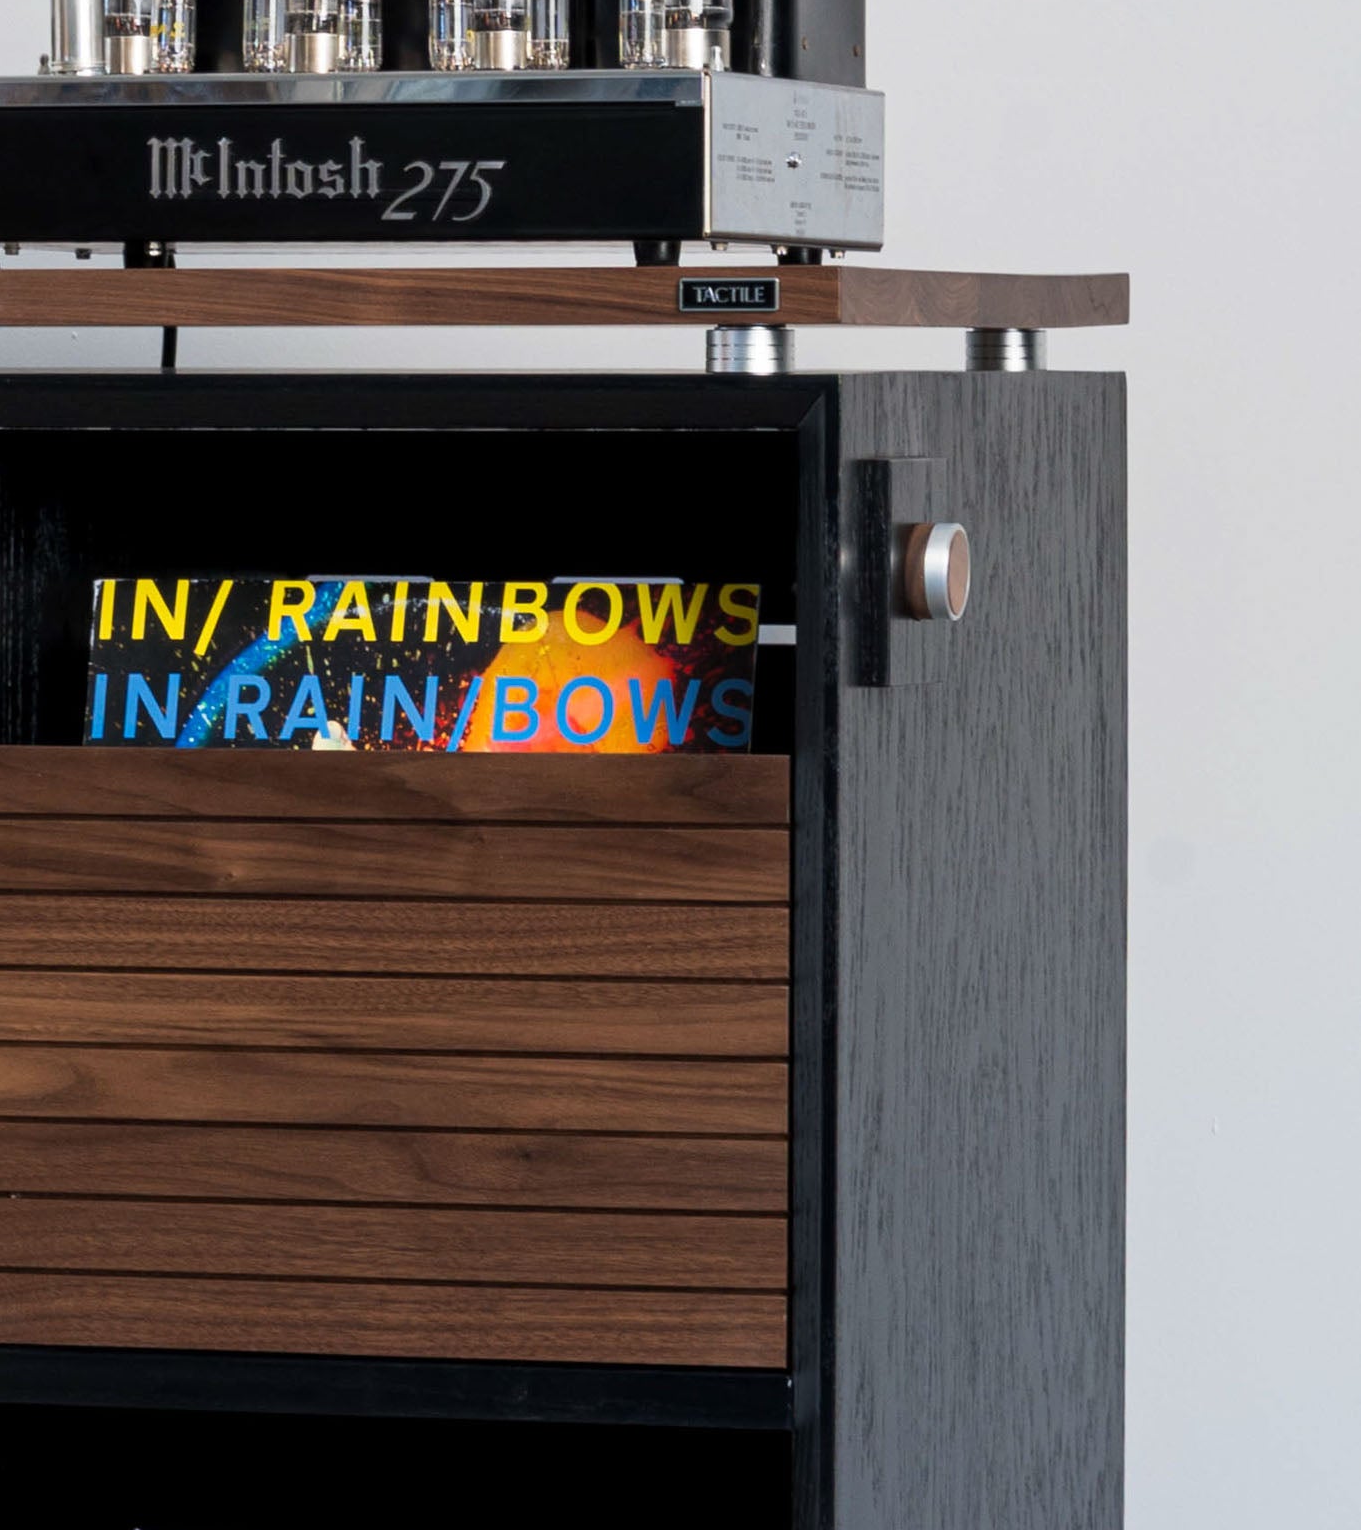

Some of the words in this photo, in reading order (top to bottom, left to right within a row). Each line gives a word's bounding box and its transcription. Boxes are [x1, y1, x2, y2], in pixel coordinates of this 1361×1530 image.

[147, 136, 383, 199] McIntosh
[381, 160, 507, 222] 275
[692, 286, 766, 303] TACTILE
[267, 580, 760, 646] RAINBOWS
[90, 673, 181, 739] IN
